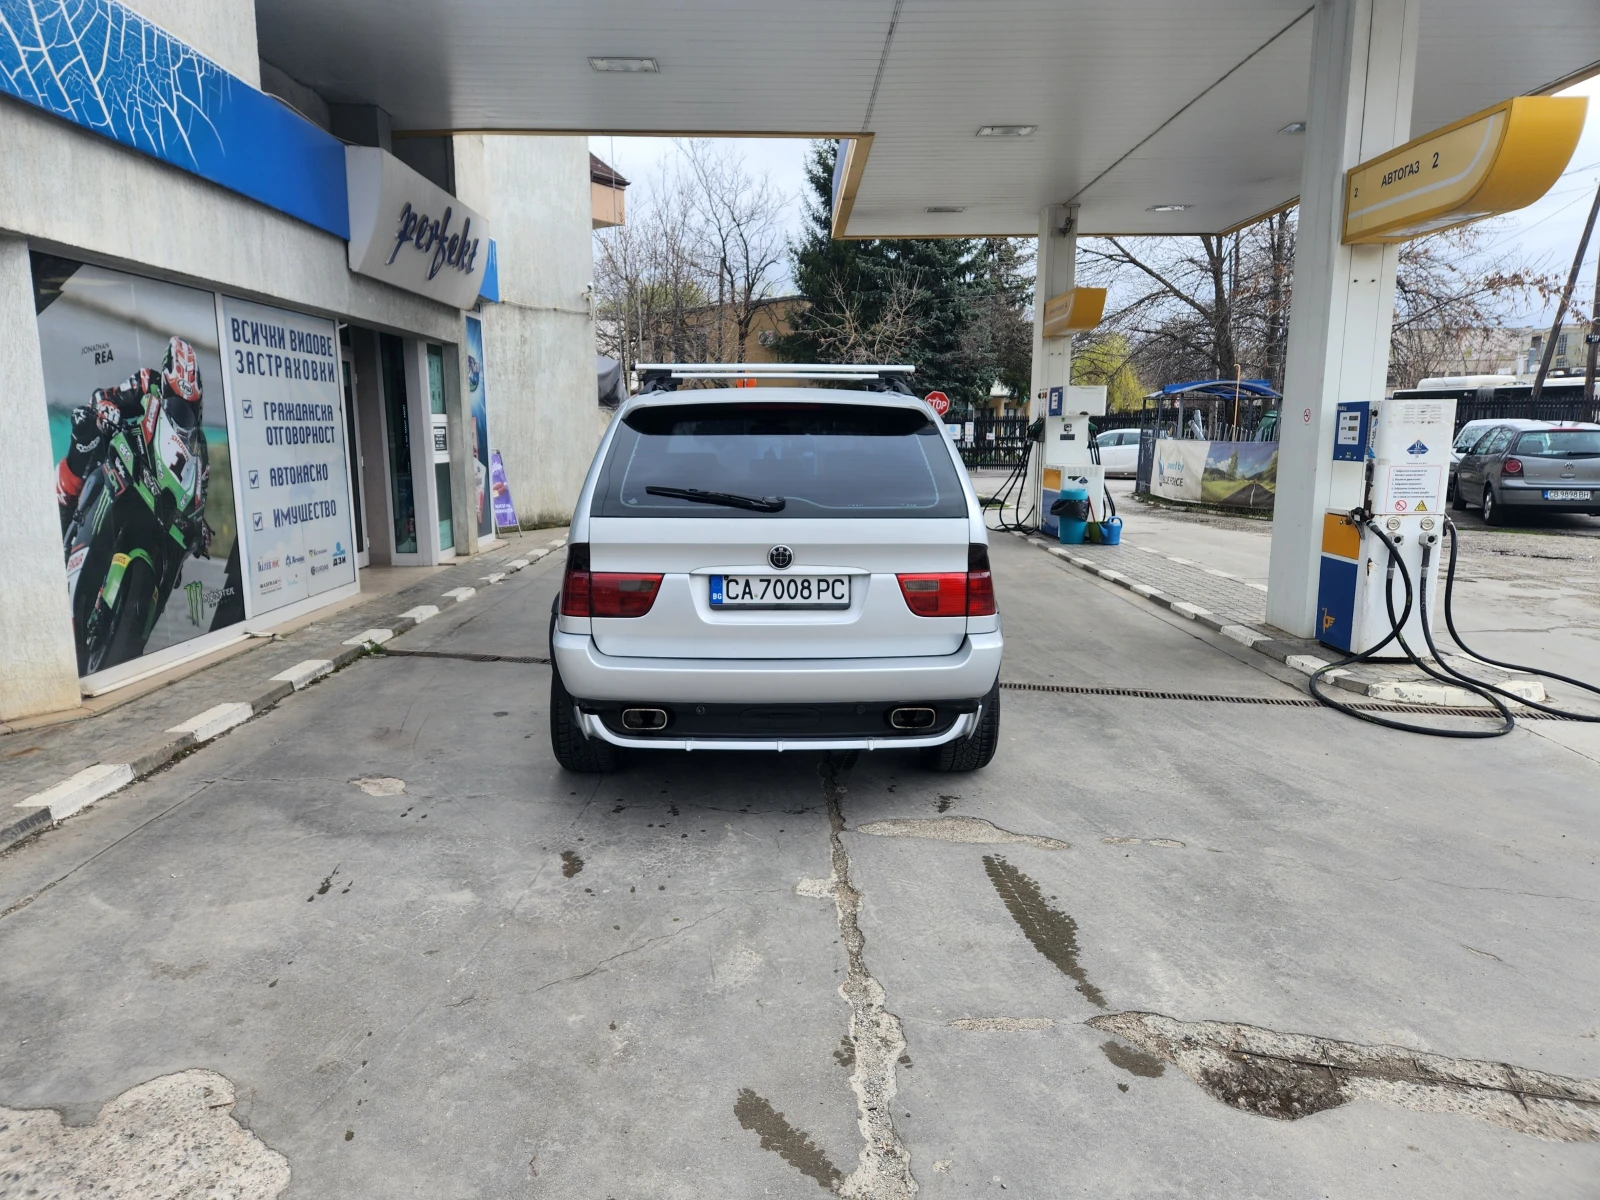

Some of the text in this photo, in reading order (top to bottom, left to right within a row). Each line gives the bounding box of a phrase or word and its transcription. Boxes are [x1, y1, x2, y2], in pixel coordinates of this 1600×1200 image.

[1381, 152, 1439, 188] АВТОГАЗ 2
[1354, 187, 1359, 198] 2
[385, 201, 480, 281] perfekt
[231, 317, 333, 357] ВСИЧКИ ВИДОВЕ
[81, 342, 110, 355] JONATHAN
[94, 350, 114, 365] REA
[235, 349, 335, 383] ЗАСТРАХОВКИ
[263, 401, 334, 422] ГРАЖДАНСКА
[927, 398, 947, 410] STOP
[265, 426, 335, 446] ОТГОВОРНОСТ
[269, 463, 328, 487] АВТОКАСКО
[273, 499, 337, 528] ИМУЩЕСТВО
[332, 556, 347, 567] ДЗИ
[712, 592, 722, 600] BG
[759, 578, 812, 600] 7008
[817, 578, 845, 600] PC
